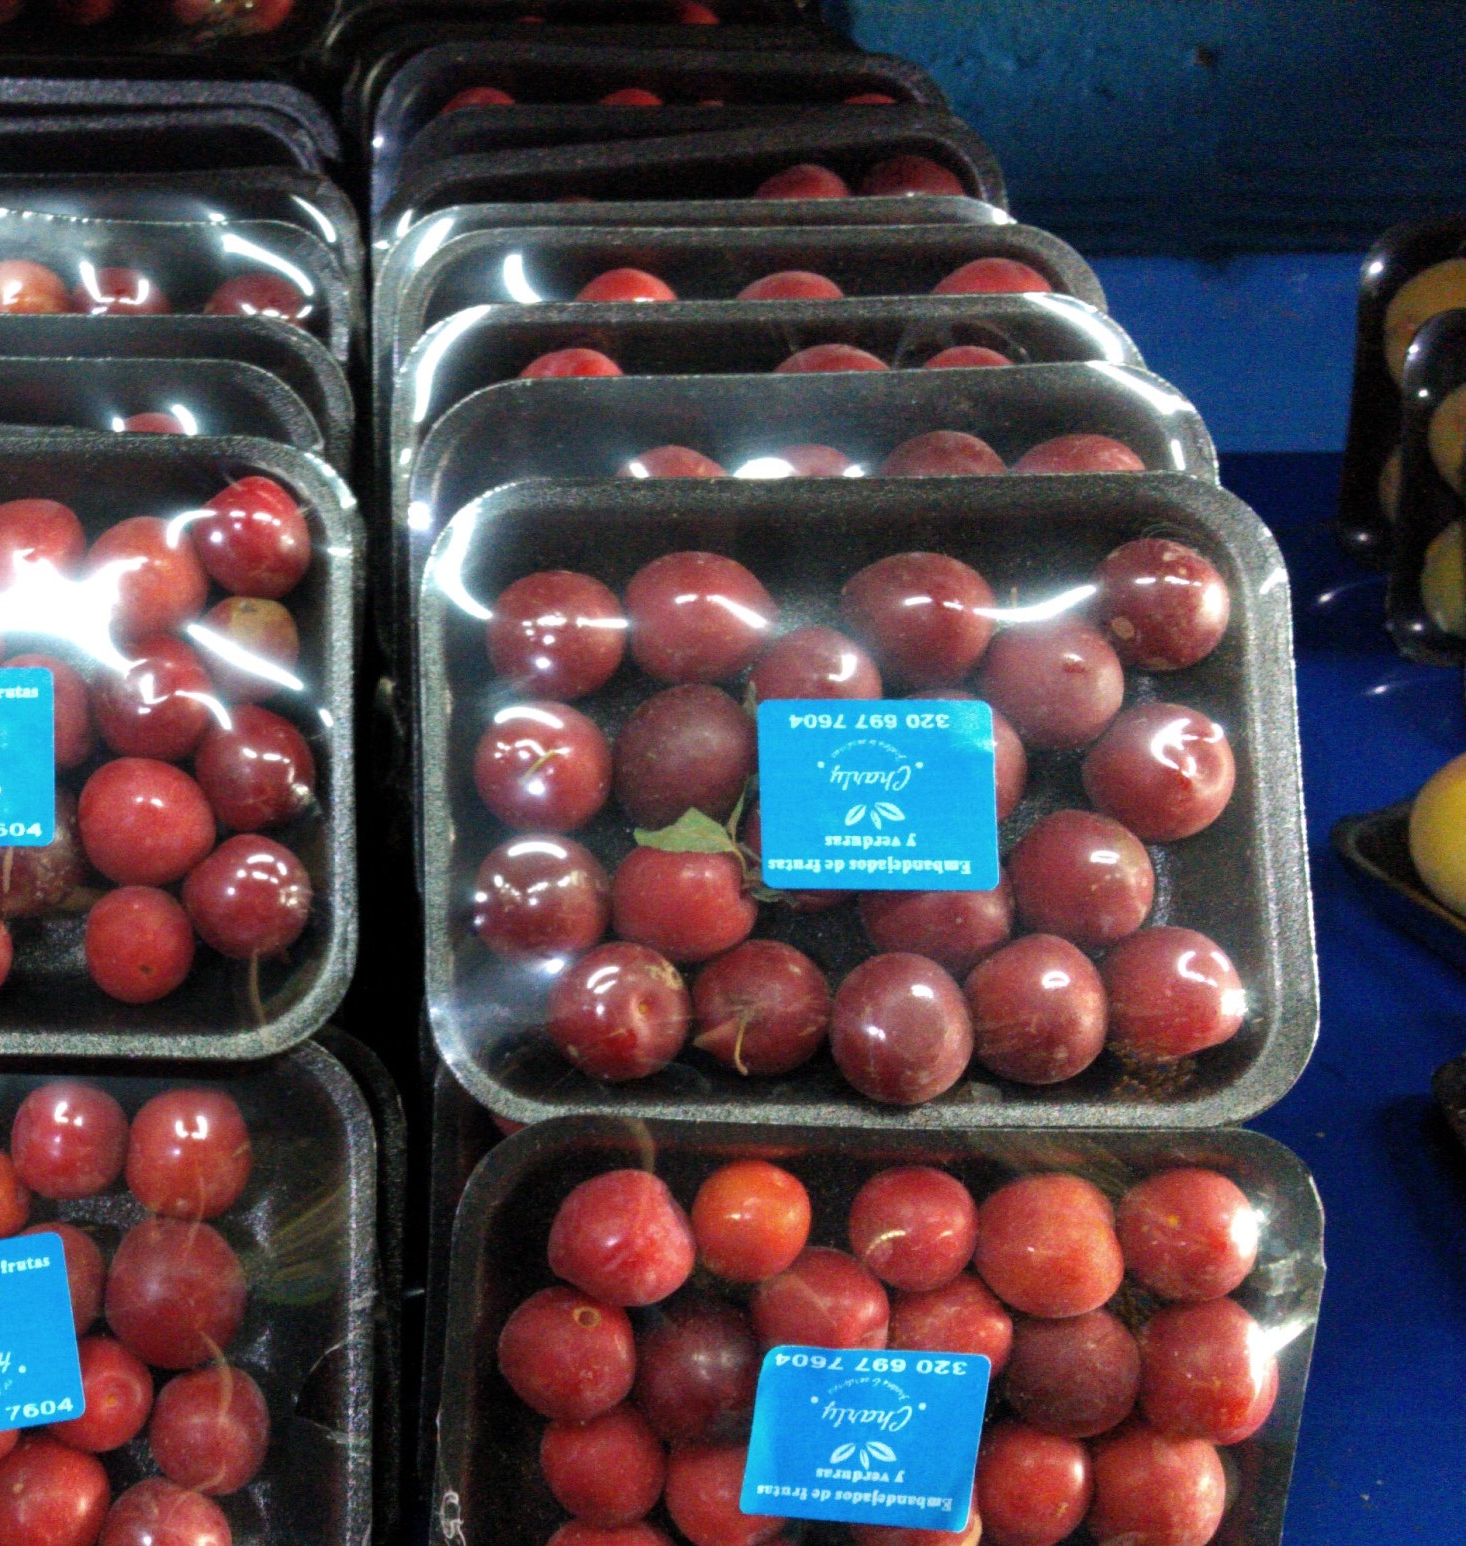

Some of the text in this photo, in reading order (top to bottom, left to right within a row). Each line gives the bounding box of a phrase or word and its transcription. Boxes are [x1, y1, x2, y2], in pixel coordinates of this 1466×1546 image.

[789, 714, 950, 729] 320 697 7604
[830, 765, 911, 791] Charly
[825, 833, 917, 850] y verduras
[768, 856, 972, 875] Embandejados de frutas
[0, 1256, 50, 1275] frutas
[775, 1353, 968, 1376] 320 697 7604
[6, 1397, 74, 1421] 7604
[821, 1401, 913, 1432] Charly
[816, 1467, 905, 1483] y verduras
[757, 1484, 954, 1512] Embandejados de frutas
